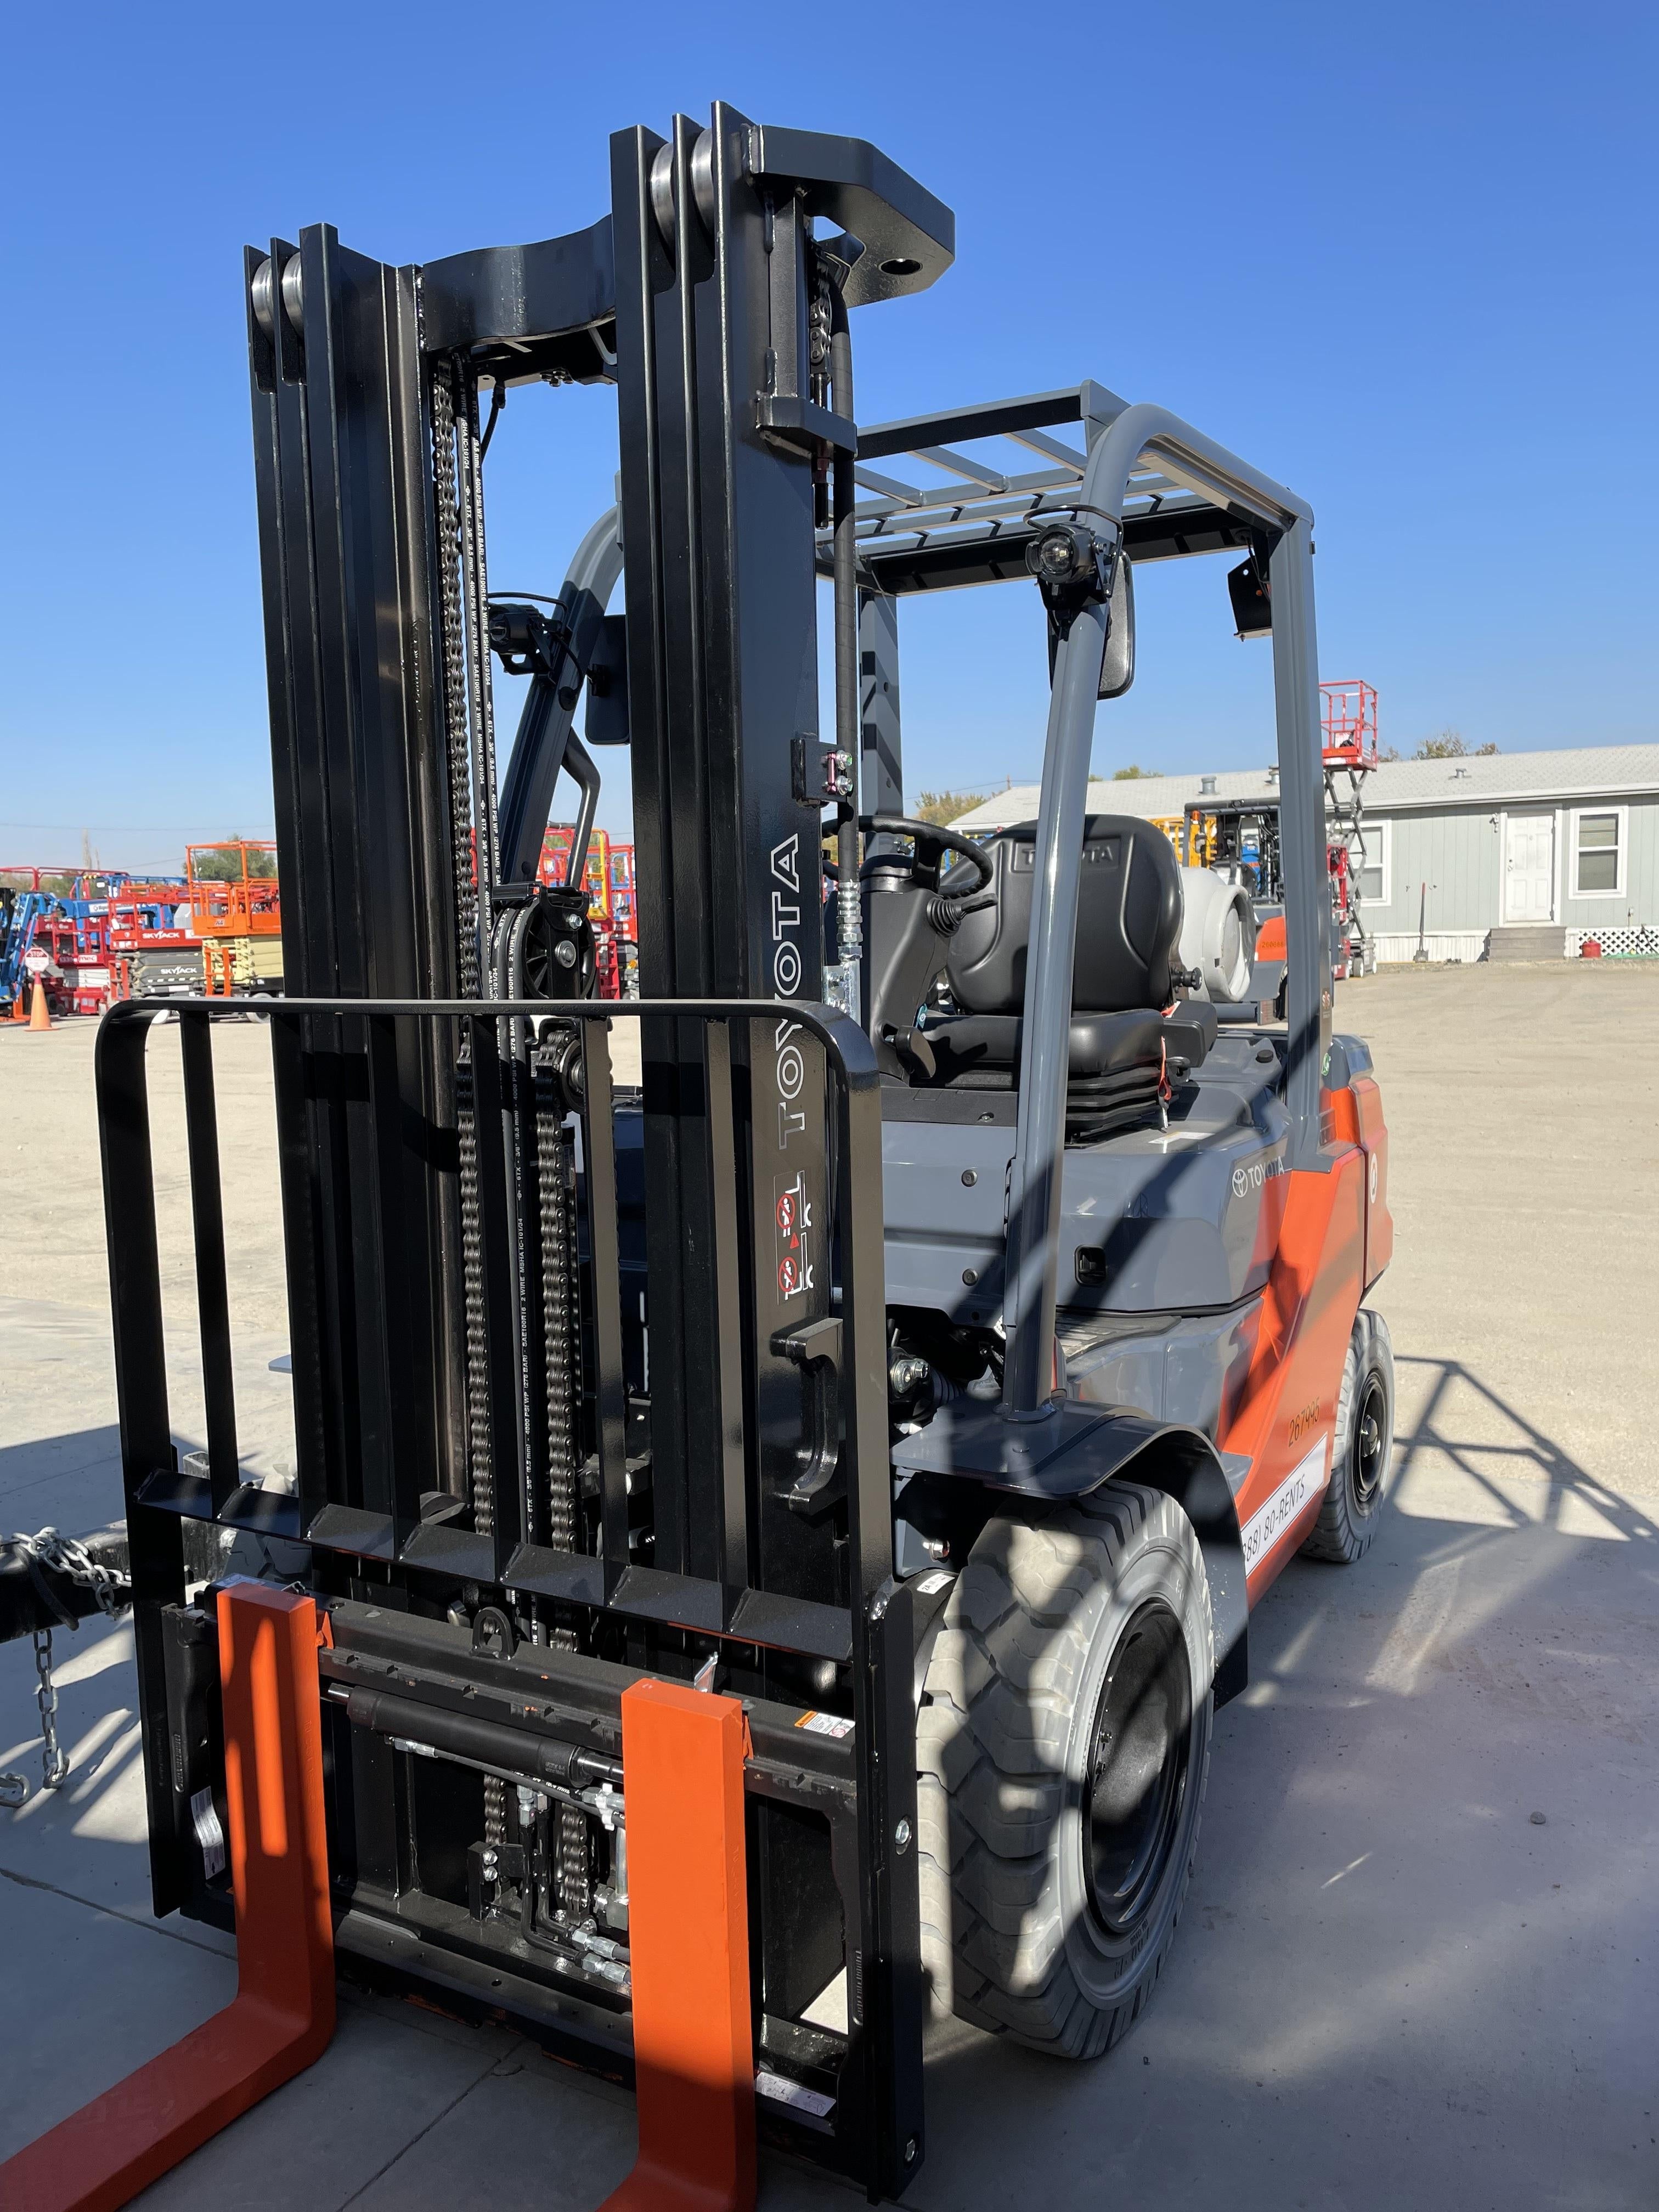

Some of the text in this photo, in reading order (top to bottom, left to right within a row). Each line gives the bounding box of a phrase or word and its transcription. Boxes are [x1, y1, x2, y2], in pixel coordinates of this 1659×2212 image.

[477, 507, 483, 520] WP
[492, 822, 499, 834] WP
[471, 610, 477, 622] WP
[486, 919, 492, 930] WP
[1022, 846, 1113, 865] TTA
[142, 930, 180, 940] SKYJACK
[160, 966, 198, 975] SKYJACK
[771, 833, 806, 1150] TOYOTA
[1247, 1155, 1285, 1189] TOYOTA
[524, 1391, 530, 1403] WP
[1288, 1397, 1320, 1448] 267995
[1242, 1474, 1305, 1562] 88) 80-RENTS
